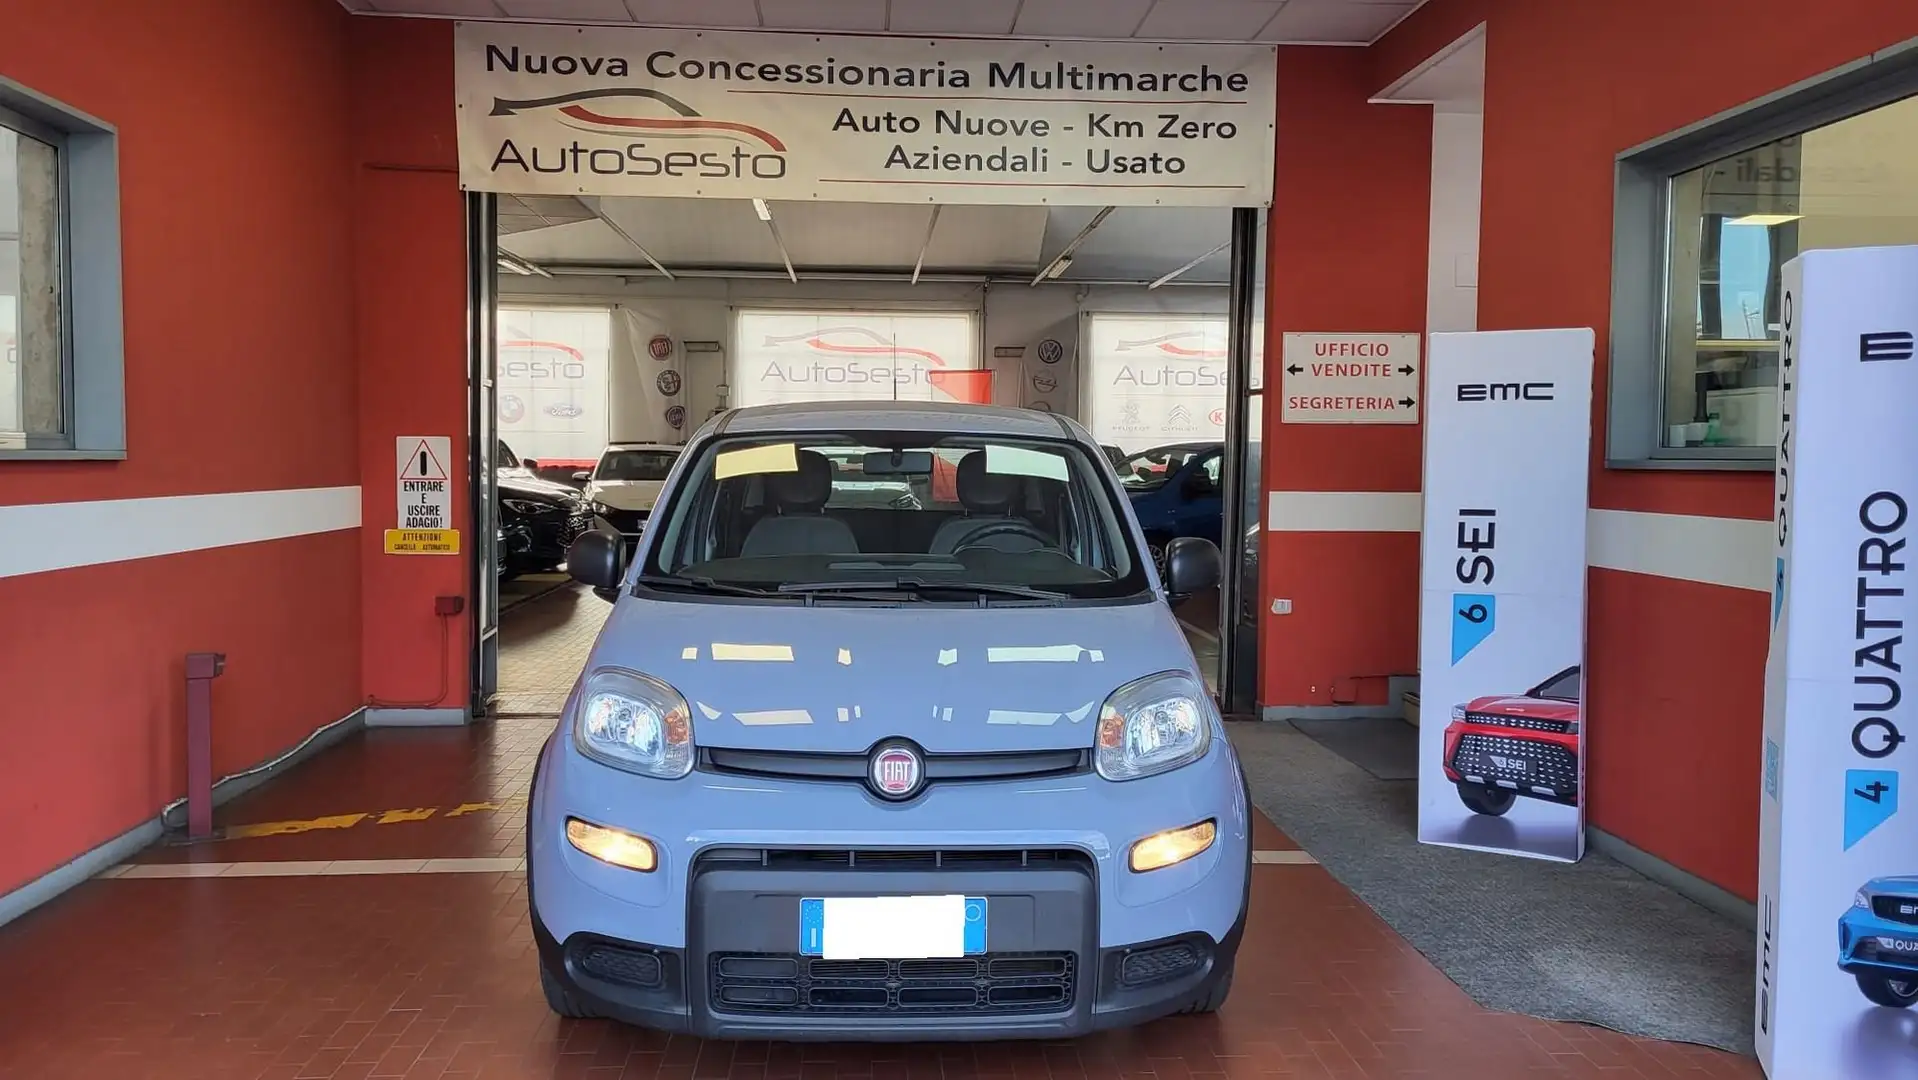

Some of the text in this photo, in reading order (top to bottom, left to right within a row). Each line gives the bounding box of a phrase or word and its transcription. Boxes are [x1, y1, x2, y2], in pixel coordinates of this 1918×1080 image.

[486, 44, 1249, 94] Nuova Concessionaria Multimarche
[832, 107, 920, 134] Auto
[935, 109, 1050, 137] Nuove
[1087, 112, 1144, 138] Km
[1157, 113, 1237, 139] Zero
[491, 138, 786, 179] AutoSesto
[884, 144, 1048, 173] Aziendali
[1087, 148, 1186, 175] Usato
[1315, 343, 1389, 357] UFFICIO
[1311, 363, 1392, 377] VENDITE
[1289, 396, 1395, 410] SEGRETERIA
[1778, 290, 1793, 547] QUATTRO
[403, 481, 444, 492] ENTRARE
[421, 493, 427, 504] E
[408, 505, 441, 516] USCIRE
[405, 517, 443, 529] ADAGIO!
[402, 532, 442, 541] ATTENZIONE
[1456, 508, 1497, 624] 6 SEI
[1851, 491, 1908, 804] 4 QUATTRO
[884, 760, 911, 781] FIAT
[1507, 758, 1527, 771] SEI
